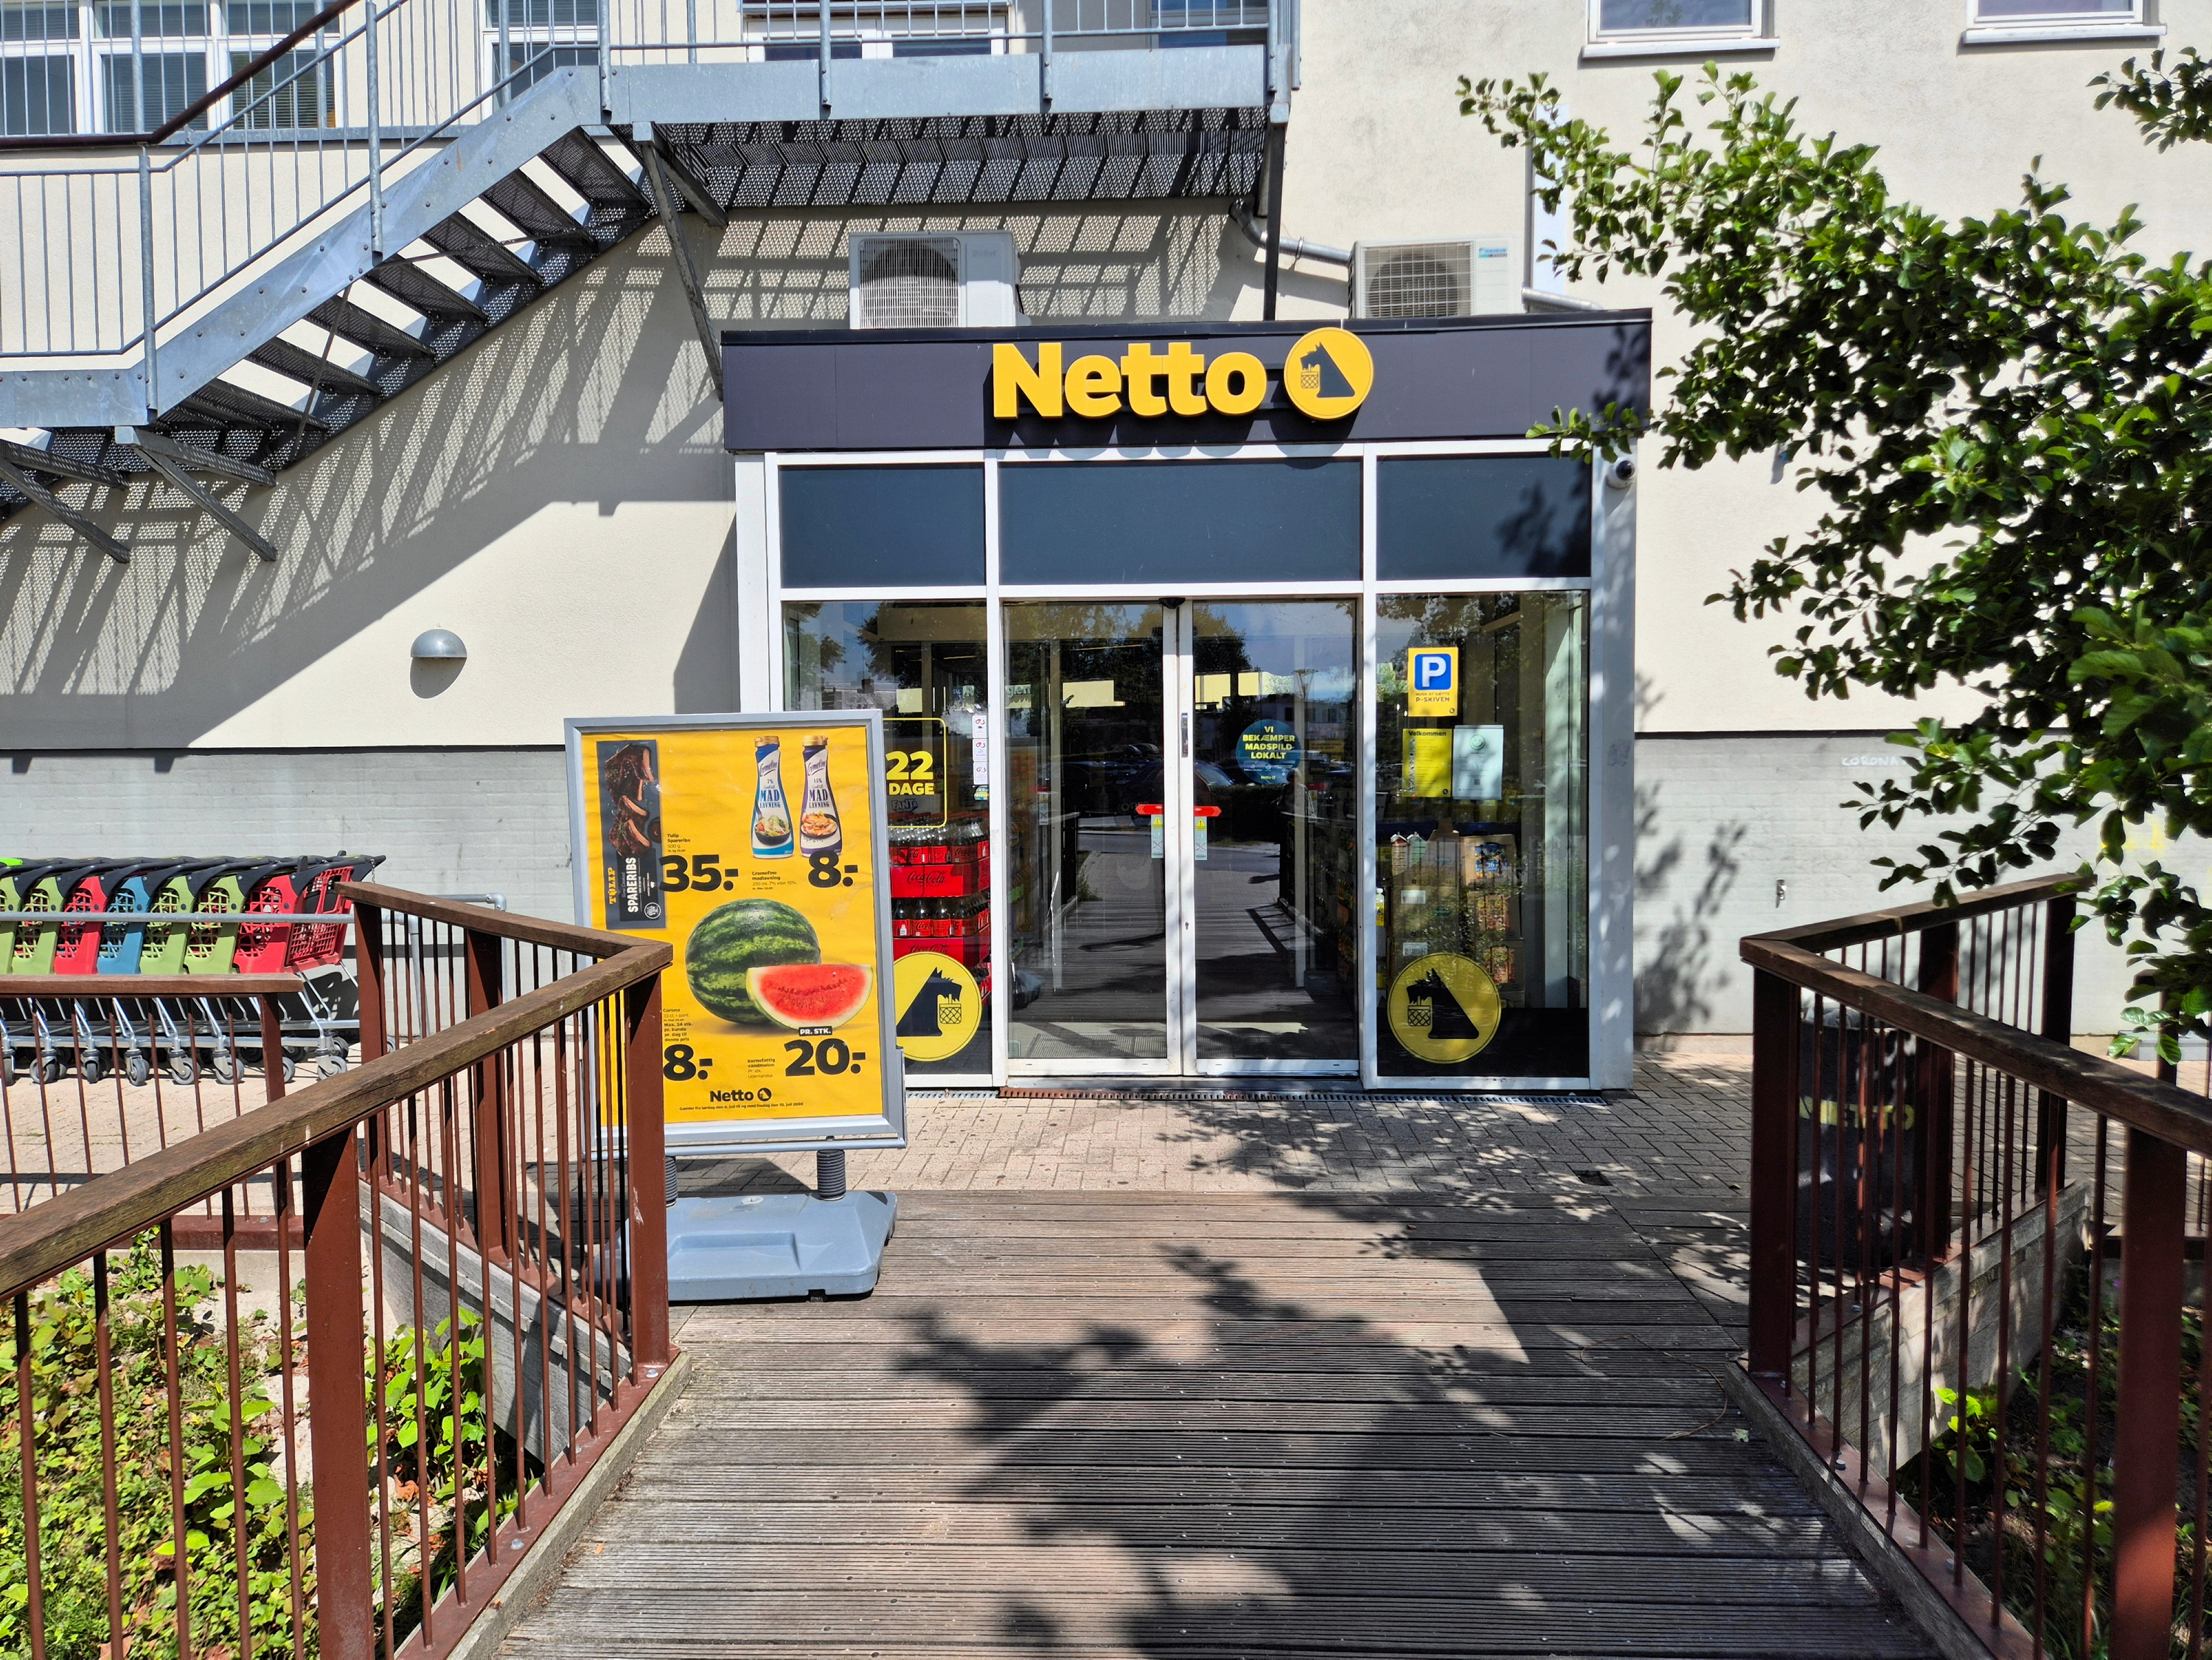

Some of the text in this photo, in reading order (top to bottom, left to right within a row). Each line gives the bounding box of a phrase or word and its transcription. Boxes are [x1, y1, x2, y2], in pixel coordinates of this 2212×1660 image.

[993, 341, 1267, 419] Netto
[1422, 656, 1447, 687] P
[885, 750, 933, 780] 22
[1251, 751, 1287, 760] LOKALT
[760, 789, 780, 802] MAD
[809, 789, 829, 802] MAD
[888, 782, 935, 796] DAGE
[607, 867, 618, 905] TULIP
[625, 857, 639, 913] SPARERIBS
[709, 1090, 754, 1102] Netto
